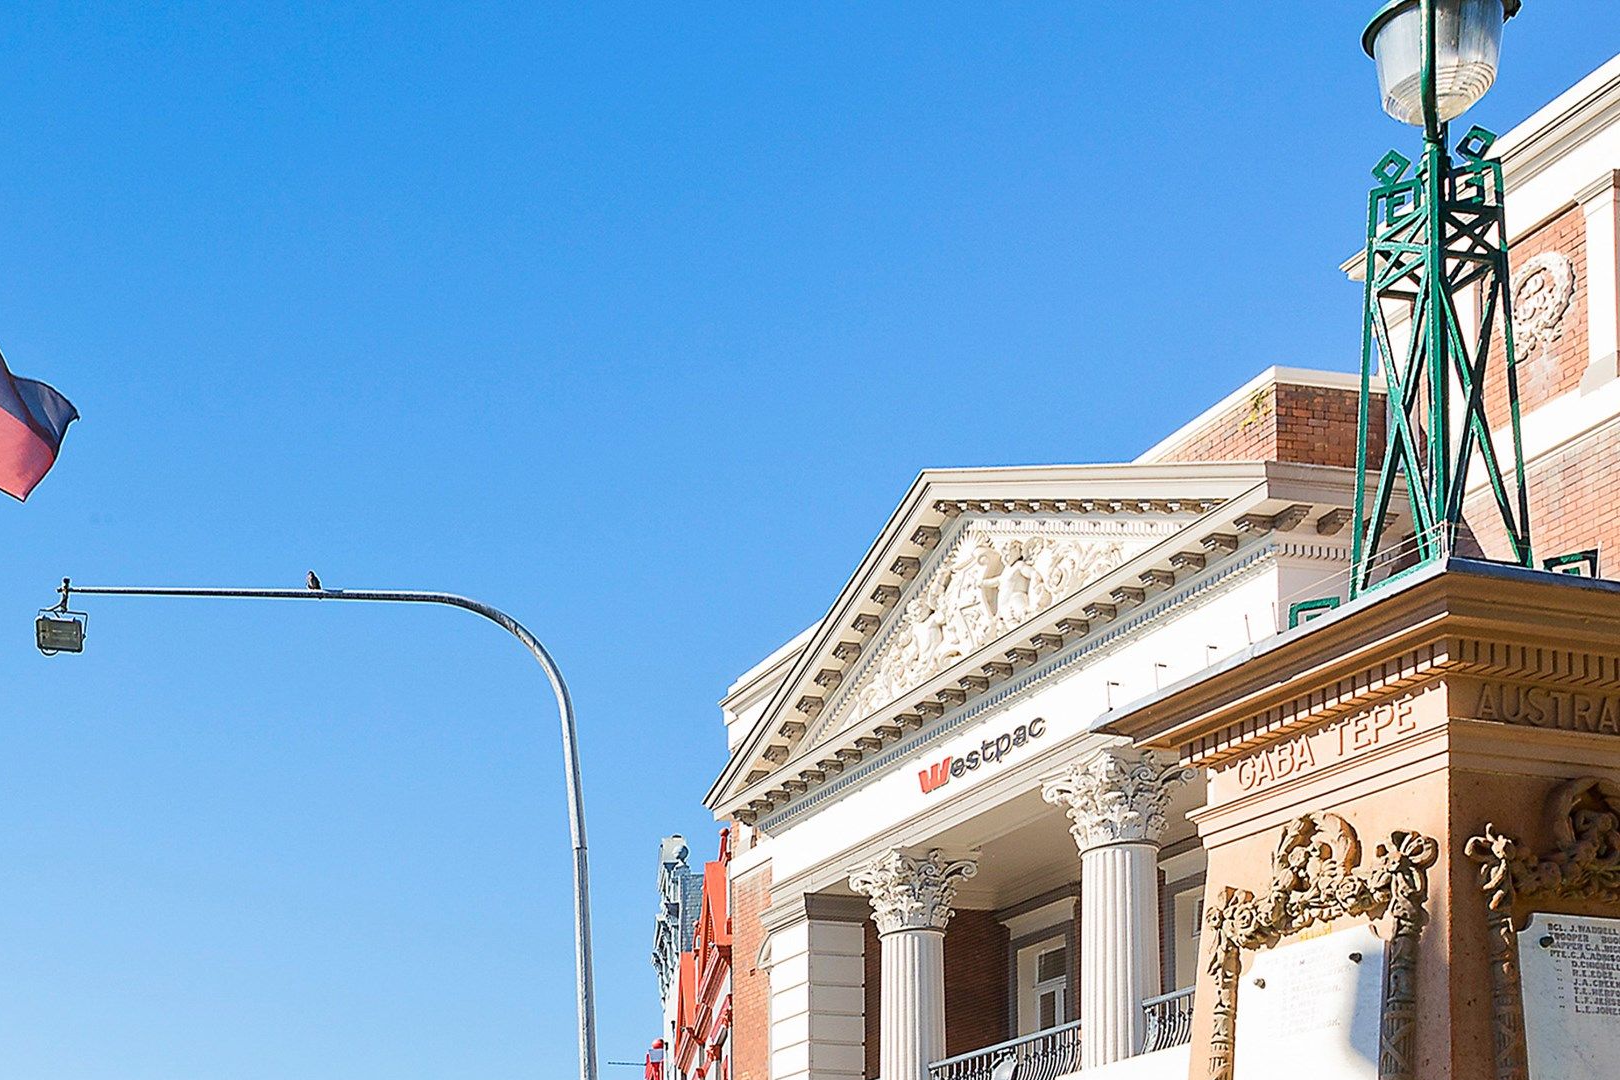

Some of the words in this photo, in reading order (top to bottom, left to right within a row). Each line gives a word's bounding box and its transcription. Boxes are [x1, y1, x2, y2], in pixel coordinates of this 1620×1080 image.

[1239, 736, 1315, 792] GABA
[1332, 694, 1417, 757] TEPE
[1476, 682, 1620, 734] AUSTRA
[918, 717, 1046, 794] Westpac
